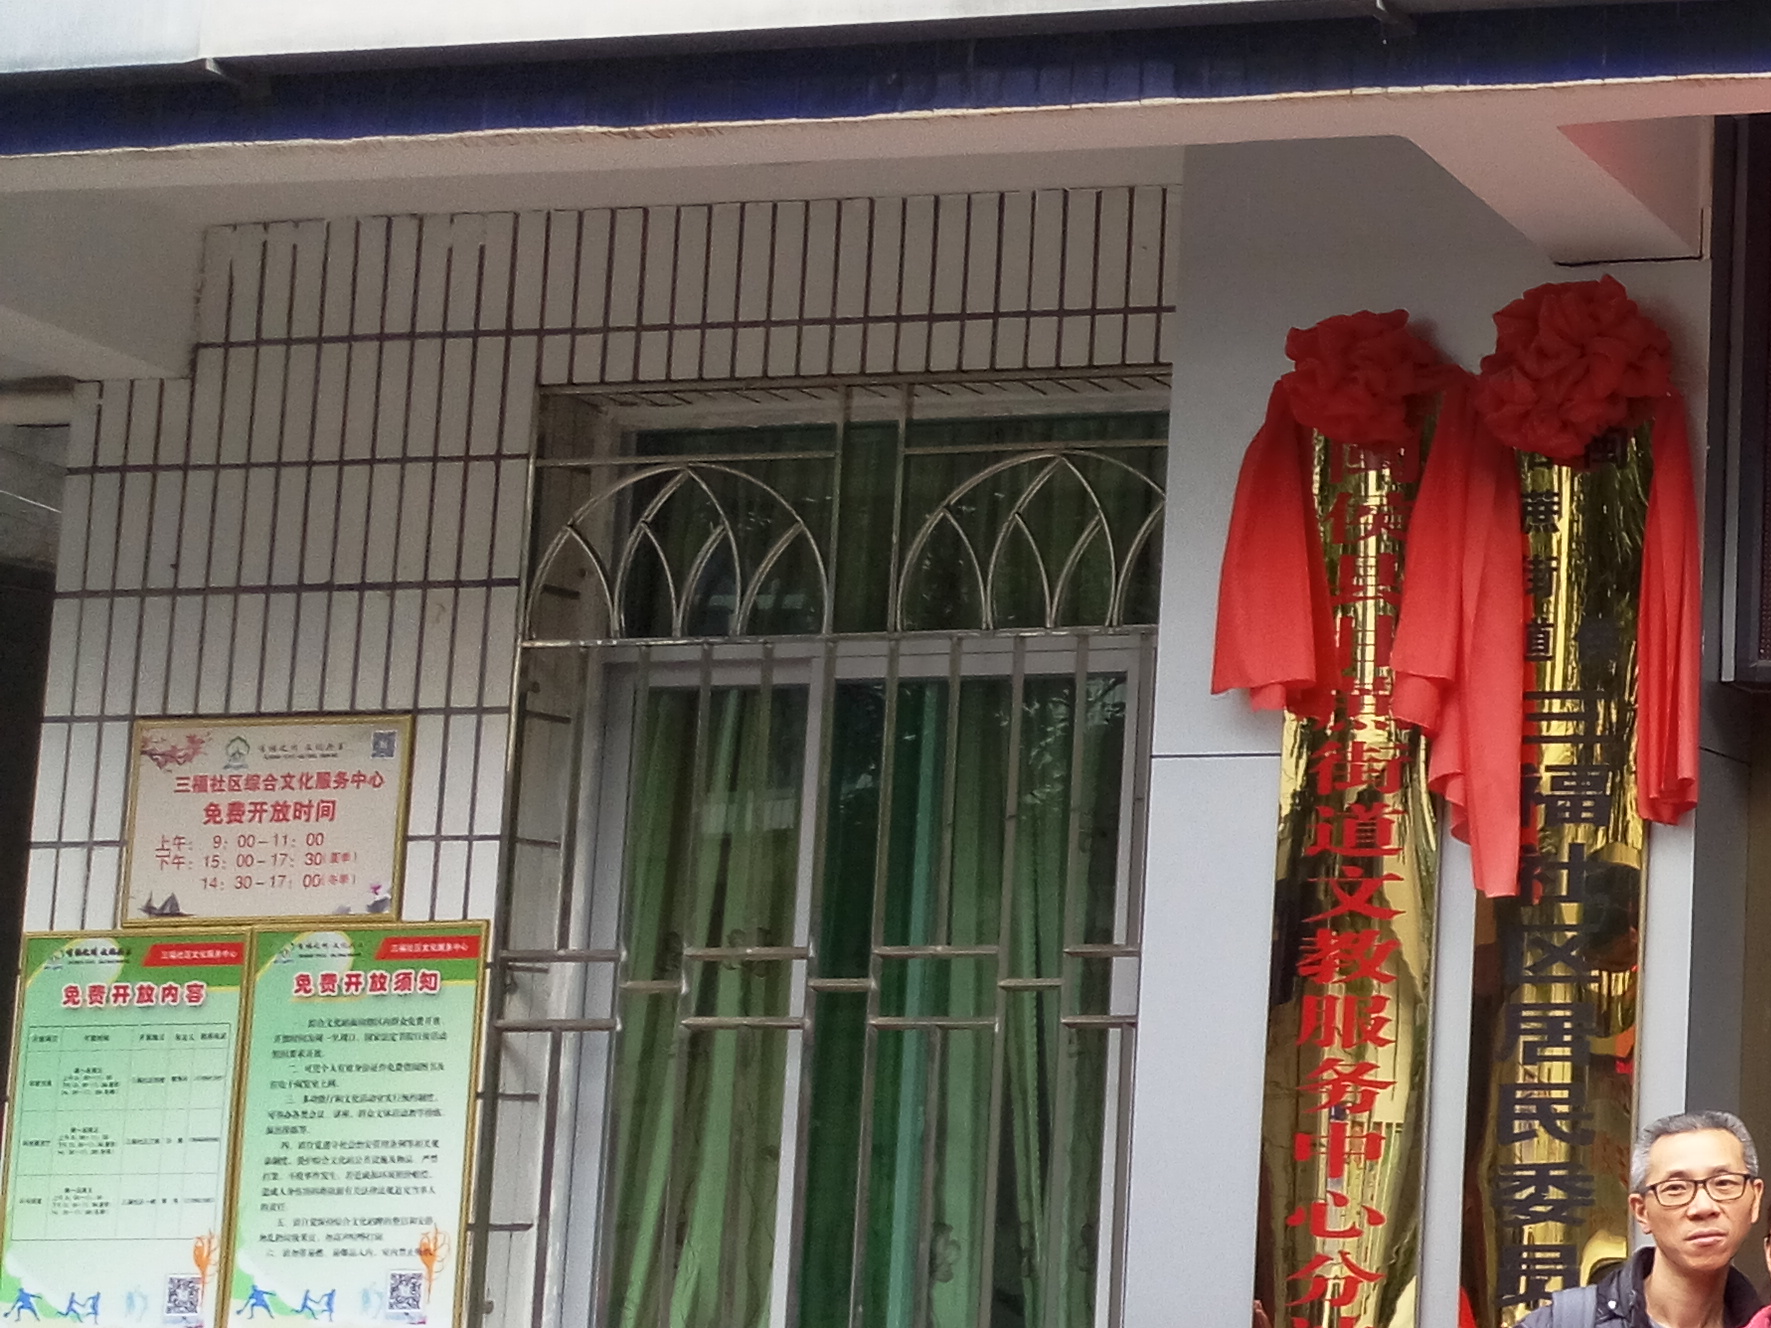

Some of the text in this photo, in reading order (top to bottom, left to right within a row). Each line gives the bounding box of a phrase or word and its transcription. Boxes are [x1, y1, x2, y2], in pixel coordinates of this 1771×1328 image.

[174, 770, 385, 794] 三福社区综合文化服务中心
[203, 799, 337, 826] 免费开放时间
[62, 982, 206, 1007] 免费开放内容
[293, 970, 441, 996] 免费开放须知
